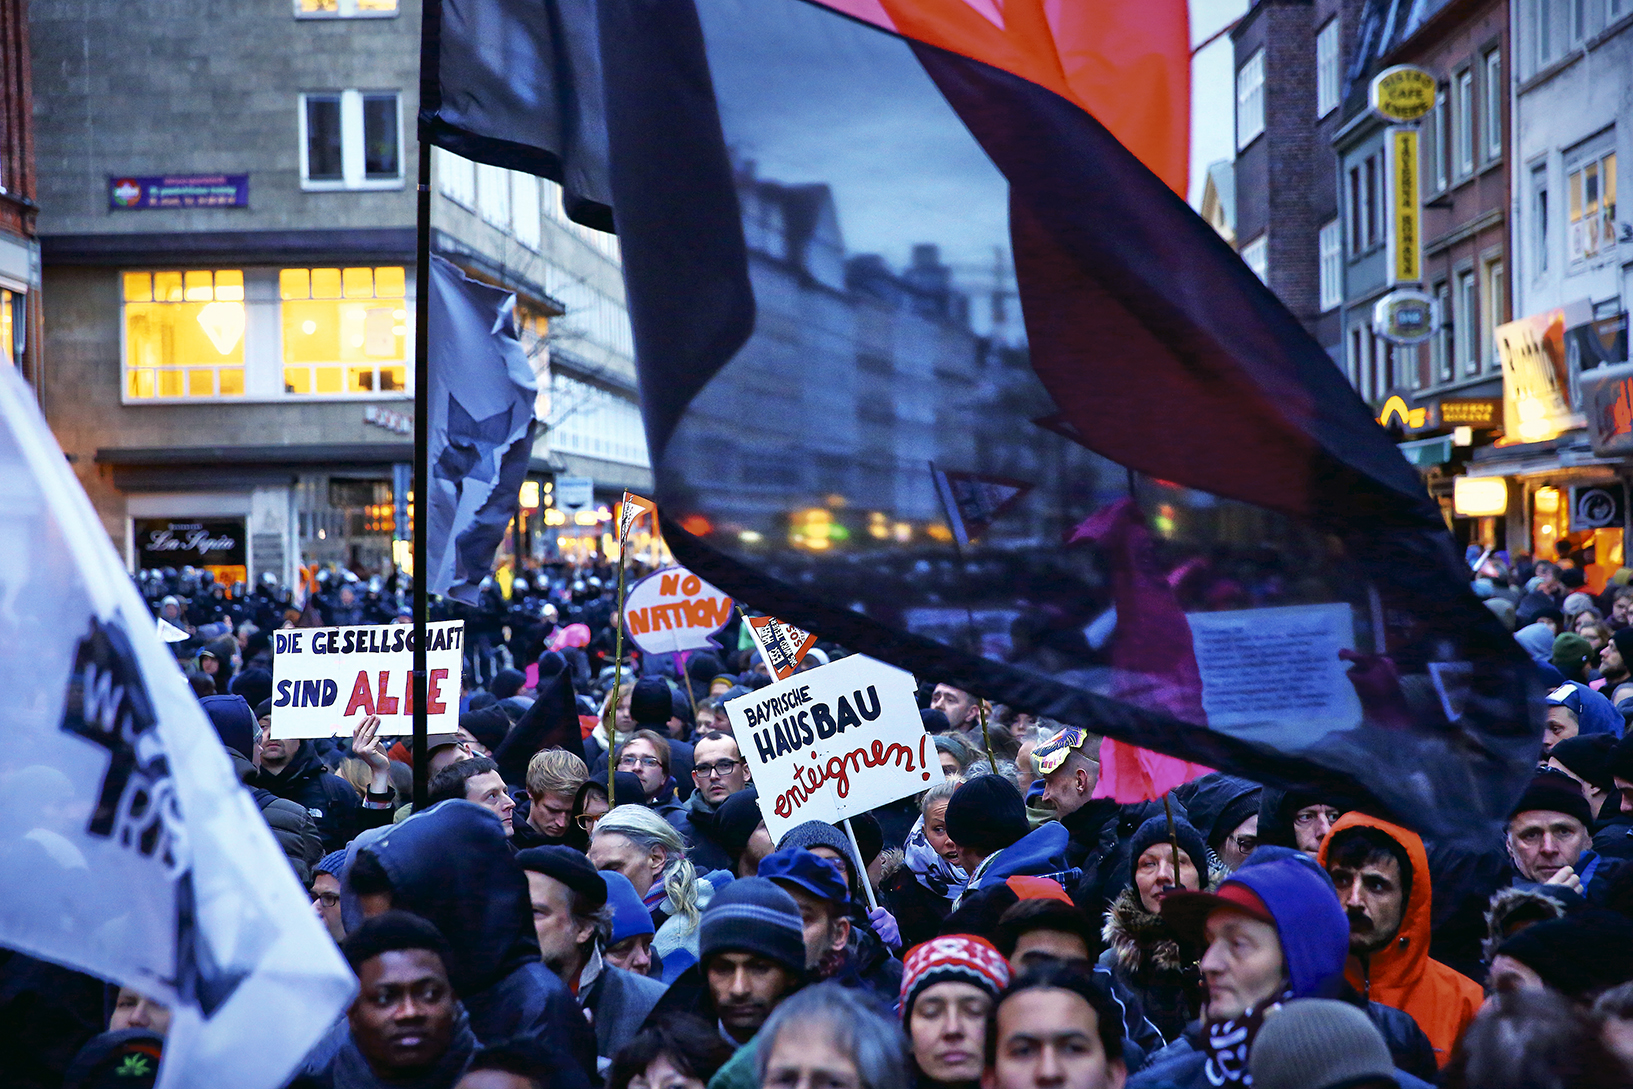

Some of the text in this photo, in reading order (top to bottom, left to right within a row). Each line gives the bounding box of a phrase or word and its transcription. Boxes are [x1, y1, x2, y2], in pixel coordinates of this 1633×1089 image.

[660, 574, 702, 596] NO
[628, 597, 733, 636] NATION
[276, 633, 302, 654] DIE
[273, 679, 338, 708] SIND
[743, 685, 813, 728] BAYRISCHE
[774, 733, 931, 818] enteignen!
